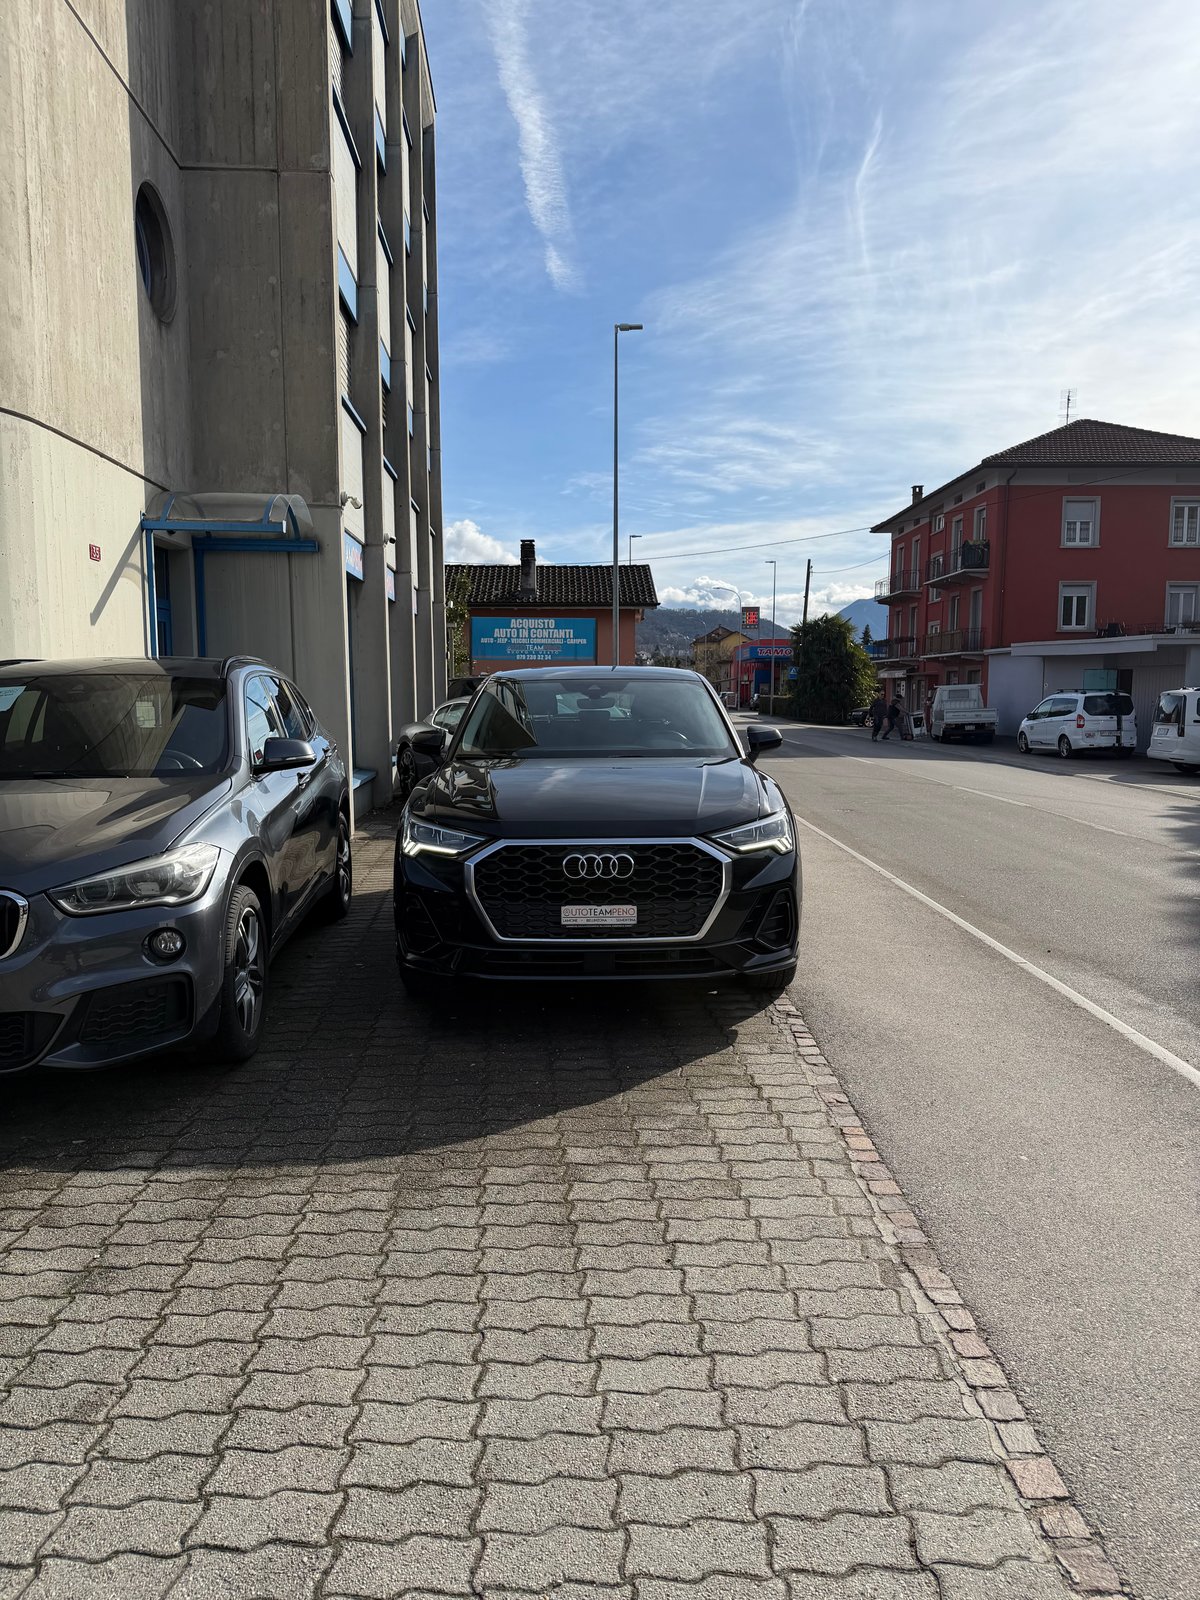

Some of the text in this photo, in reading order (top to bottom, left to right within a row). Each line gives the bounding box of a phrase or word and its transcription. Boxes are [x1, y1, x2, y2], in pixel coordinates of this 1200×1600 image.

[510, 619, 555, 629] ACQUISTO
[494, 629, 574, 638] AUTO IN CONTANTI
